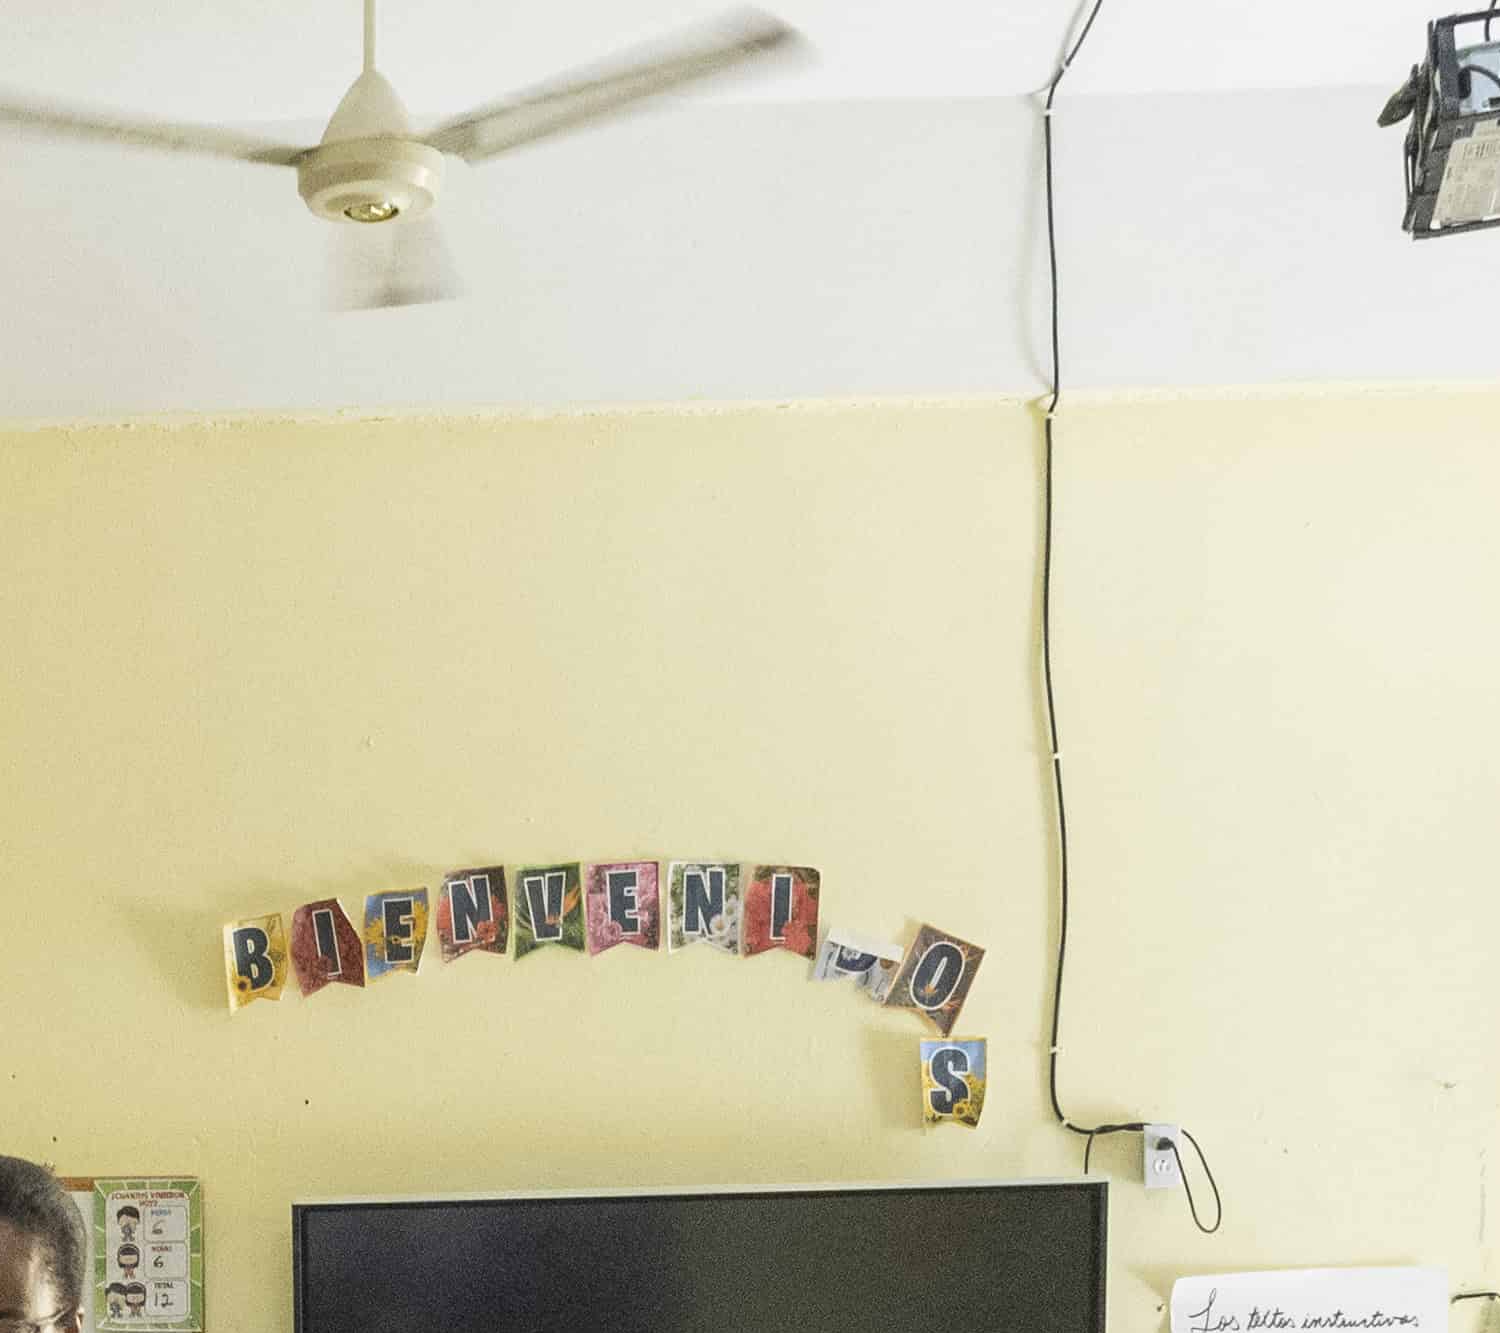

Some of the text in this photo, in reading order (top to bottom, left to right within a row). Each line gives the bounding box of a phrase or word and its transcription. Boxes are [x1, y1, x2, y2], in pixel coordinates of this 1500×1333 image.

[151, 1219, 165, 1236] 6
[153, 1255, 165, 1269] 6
[153, 1292, 175, 1309] 12
